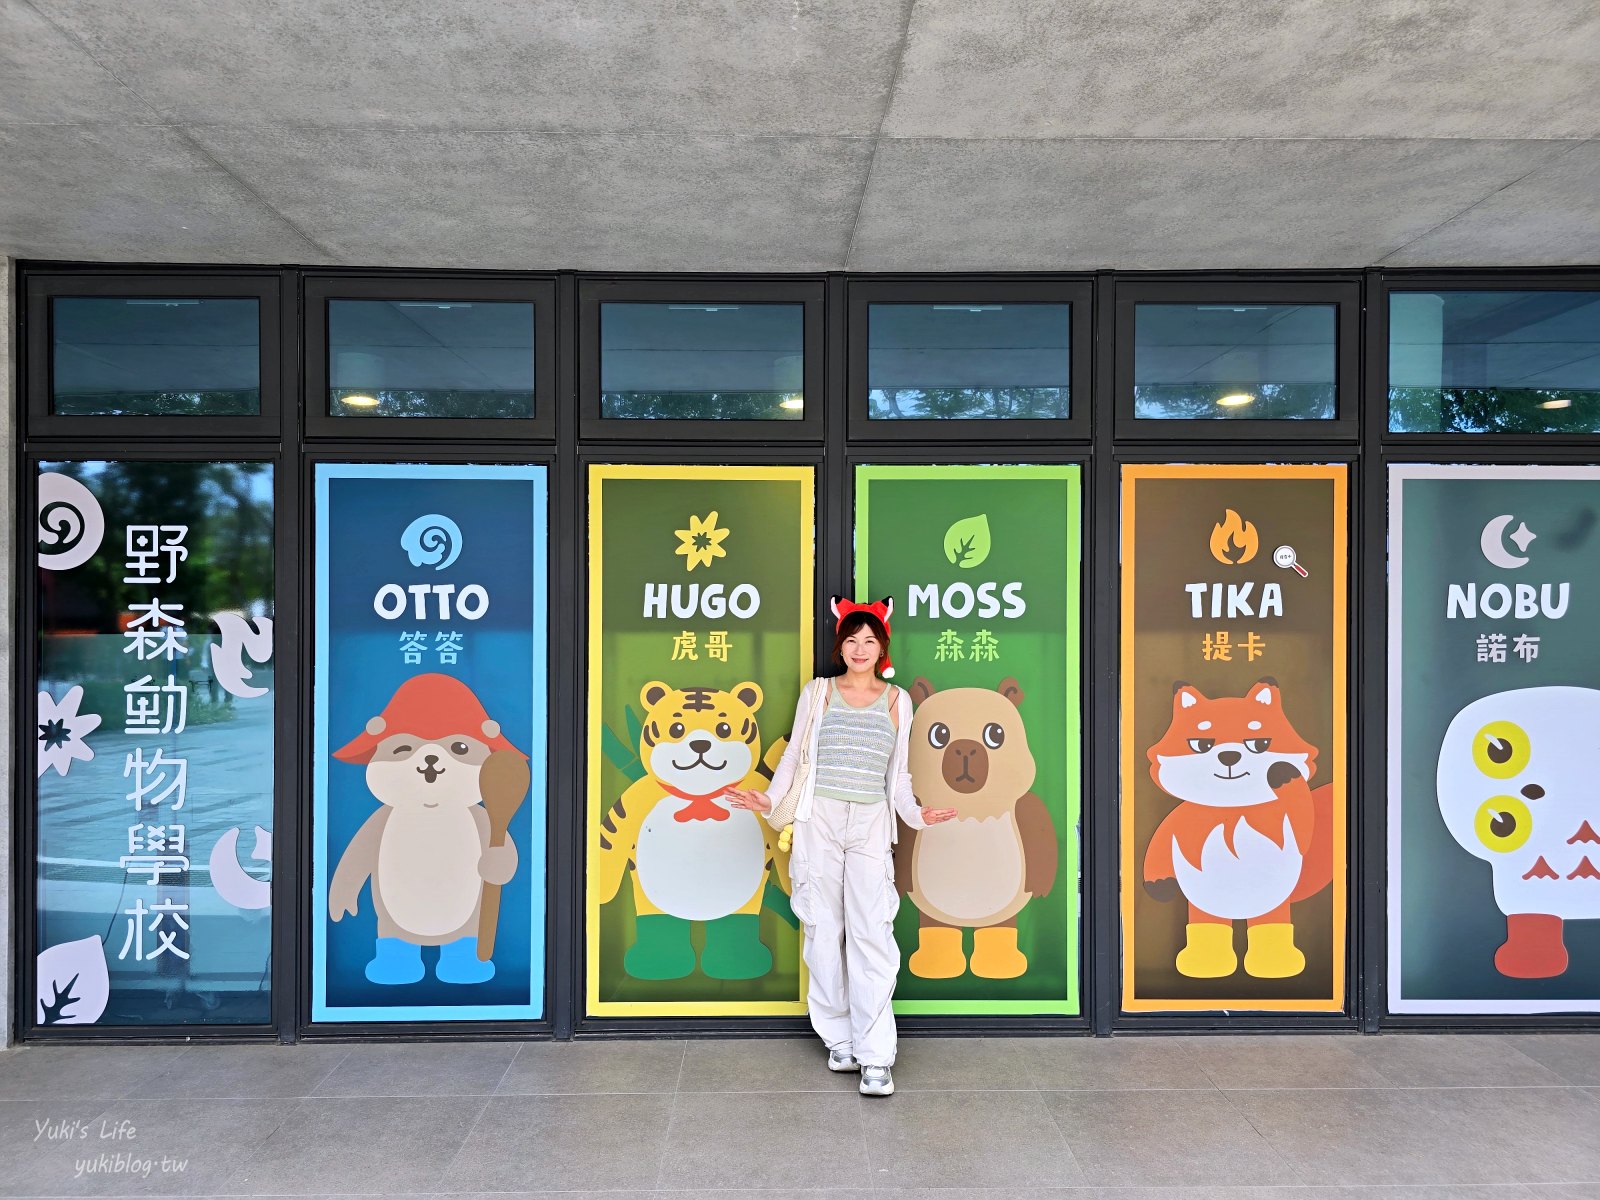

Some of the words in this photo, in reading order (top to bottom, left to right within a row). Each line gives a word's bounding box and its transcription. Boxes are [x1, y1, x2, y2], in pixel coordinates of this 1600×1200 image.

[373, 583, 489, 620] OTTO
[643, 582, 761, 619] HUGO
[908, 581, 1026, 619] MOSS
[1184, 582, 1284, 619] TIKA
[1446, 582, 1570, 620] NOBU
[399, 631, 463, 665] 答答
[671, 630, 733, 662] 虎哥
[934, 629, 1000, 662] 森森
[1202, 631, 1266, 662] 提卡
[1476, 633, 1541, 663] 諾布
[118, 525, 190, 961] 野森動物學校
